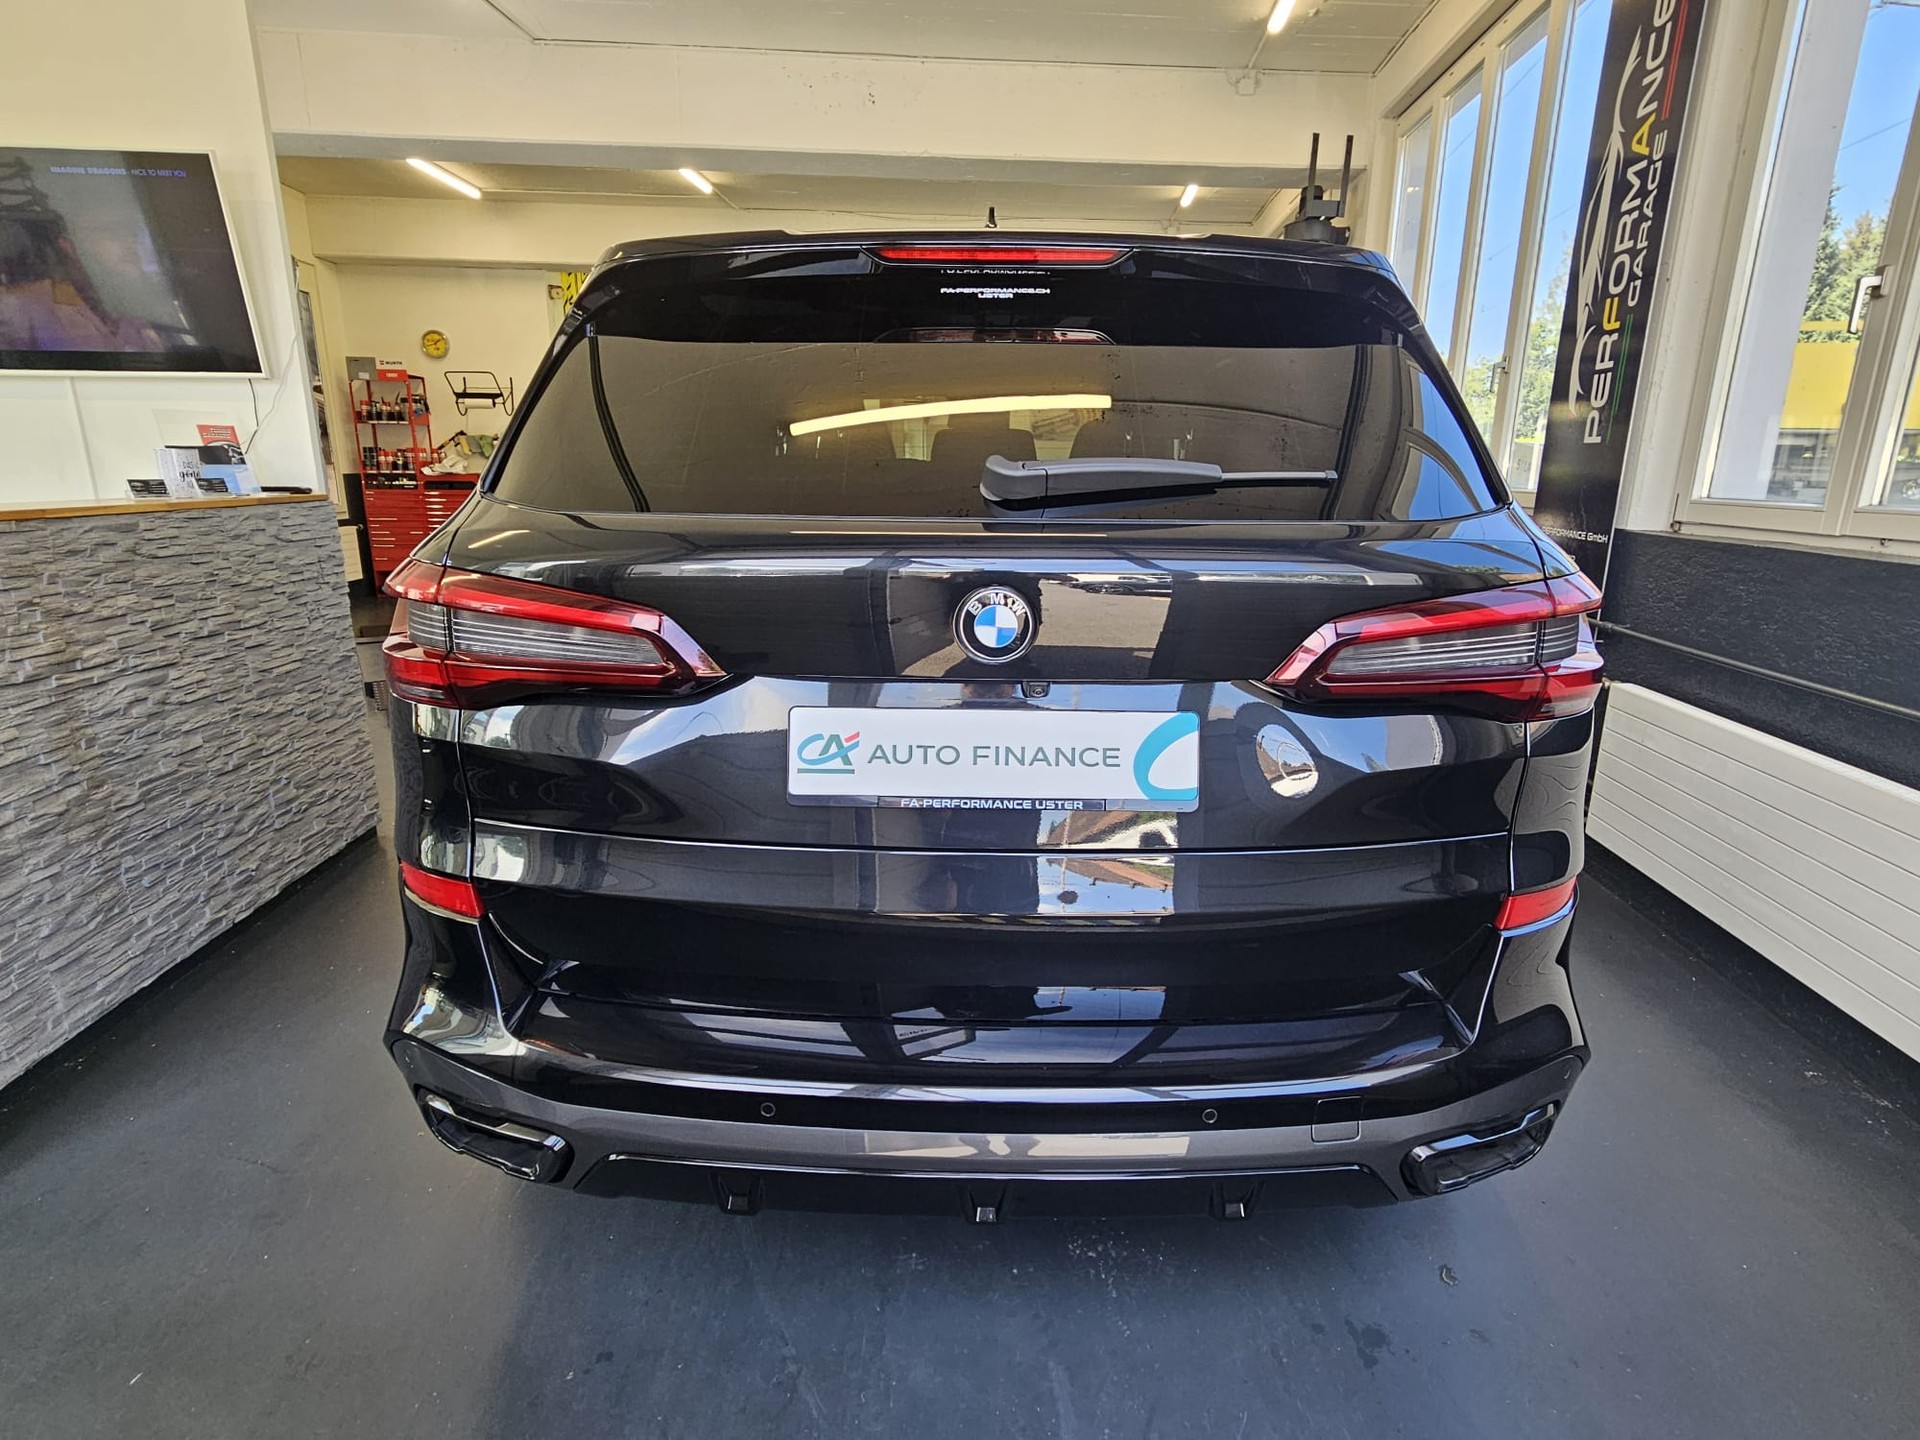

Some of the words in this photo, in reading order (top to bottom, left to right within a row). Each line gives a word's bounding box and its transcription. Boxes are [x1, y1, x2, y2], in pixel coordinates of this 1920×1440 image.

[1583, 0, 1676, 444] PERFORMANCE
[1627, 129, 1668, 307] GARAGE
[1586, 532, 1609, 544] GmbH
[967, 592, 1027, 617] BMW
[867, 743, 961, 766] AUTO
[971, 745, 1121, 769] FINANCE
[900, 797, 1032, 810] FA-PERFORMANCE
[1034, 798, 1084, 811] USTER
